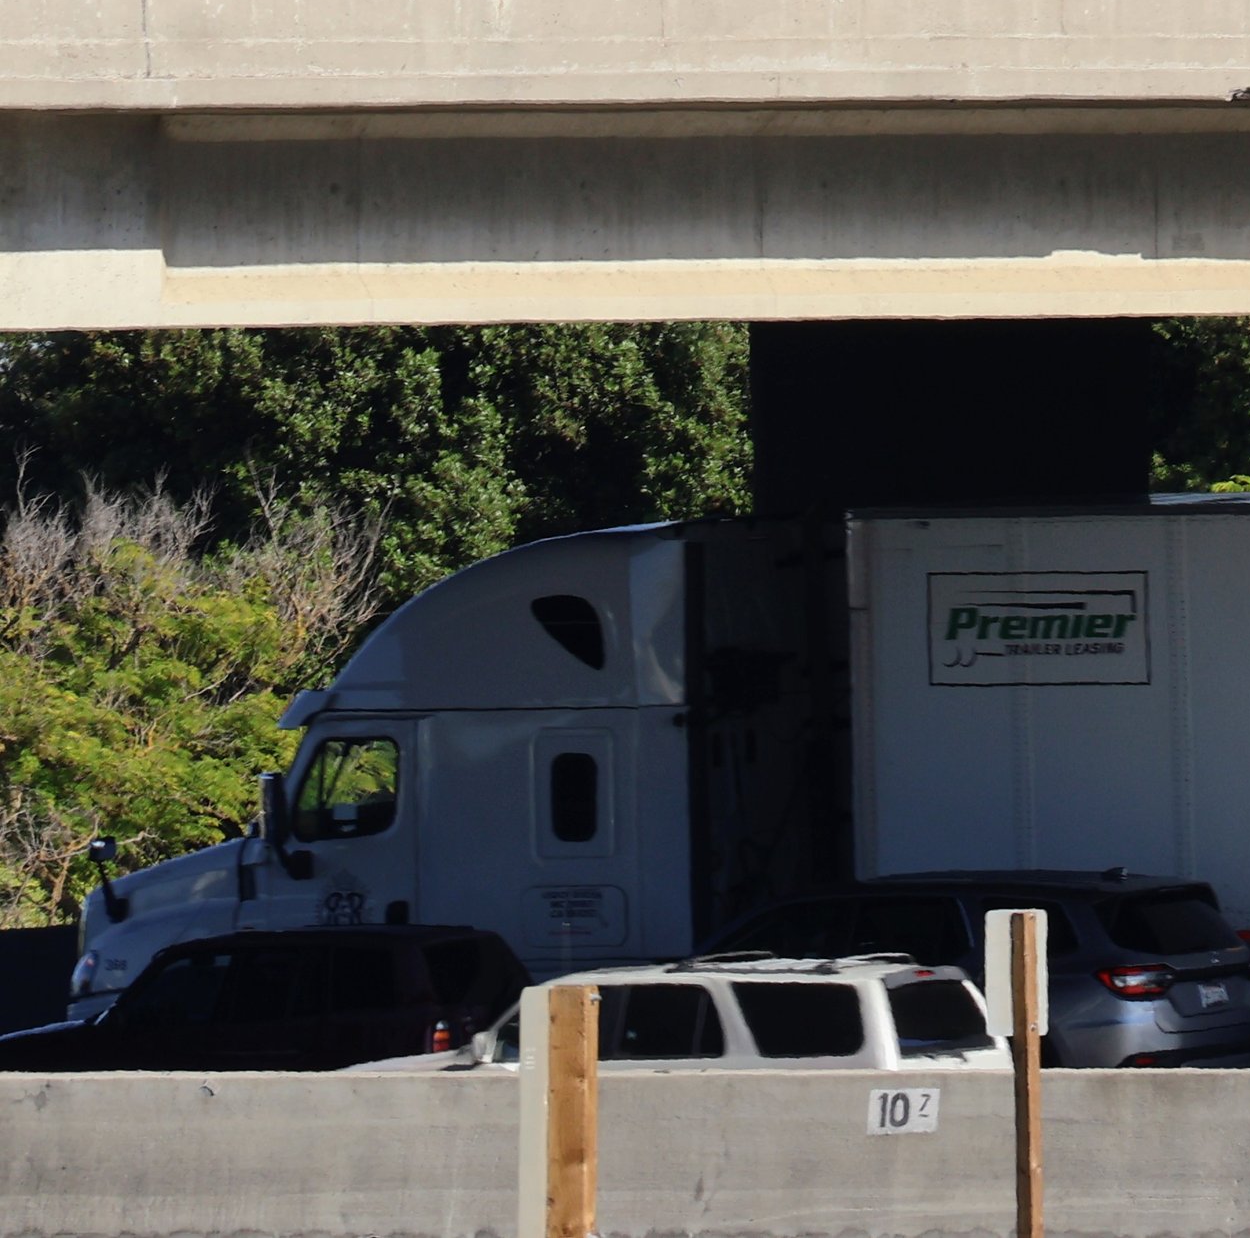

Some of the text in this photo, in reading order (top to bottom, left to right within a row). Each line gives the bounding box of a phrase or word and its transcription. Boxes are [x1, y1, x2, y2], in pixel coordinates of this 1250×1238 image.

[945, 607, 1136, 640] Premier
[1005, 642, 1125, 656] TRAILER LEASING
